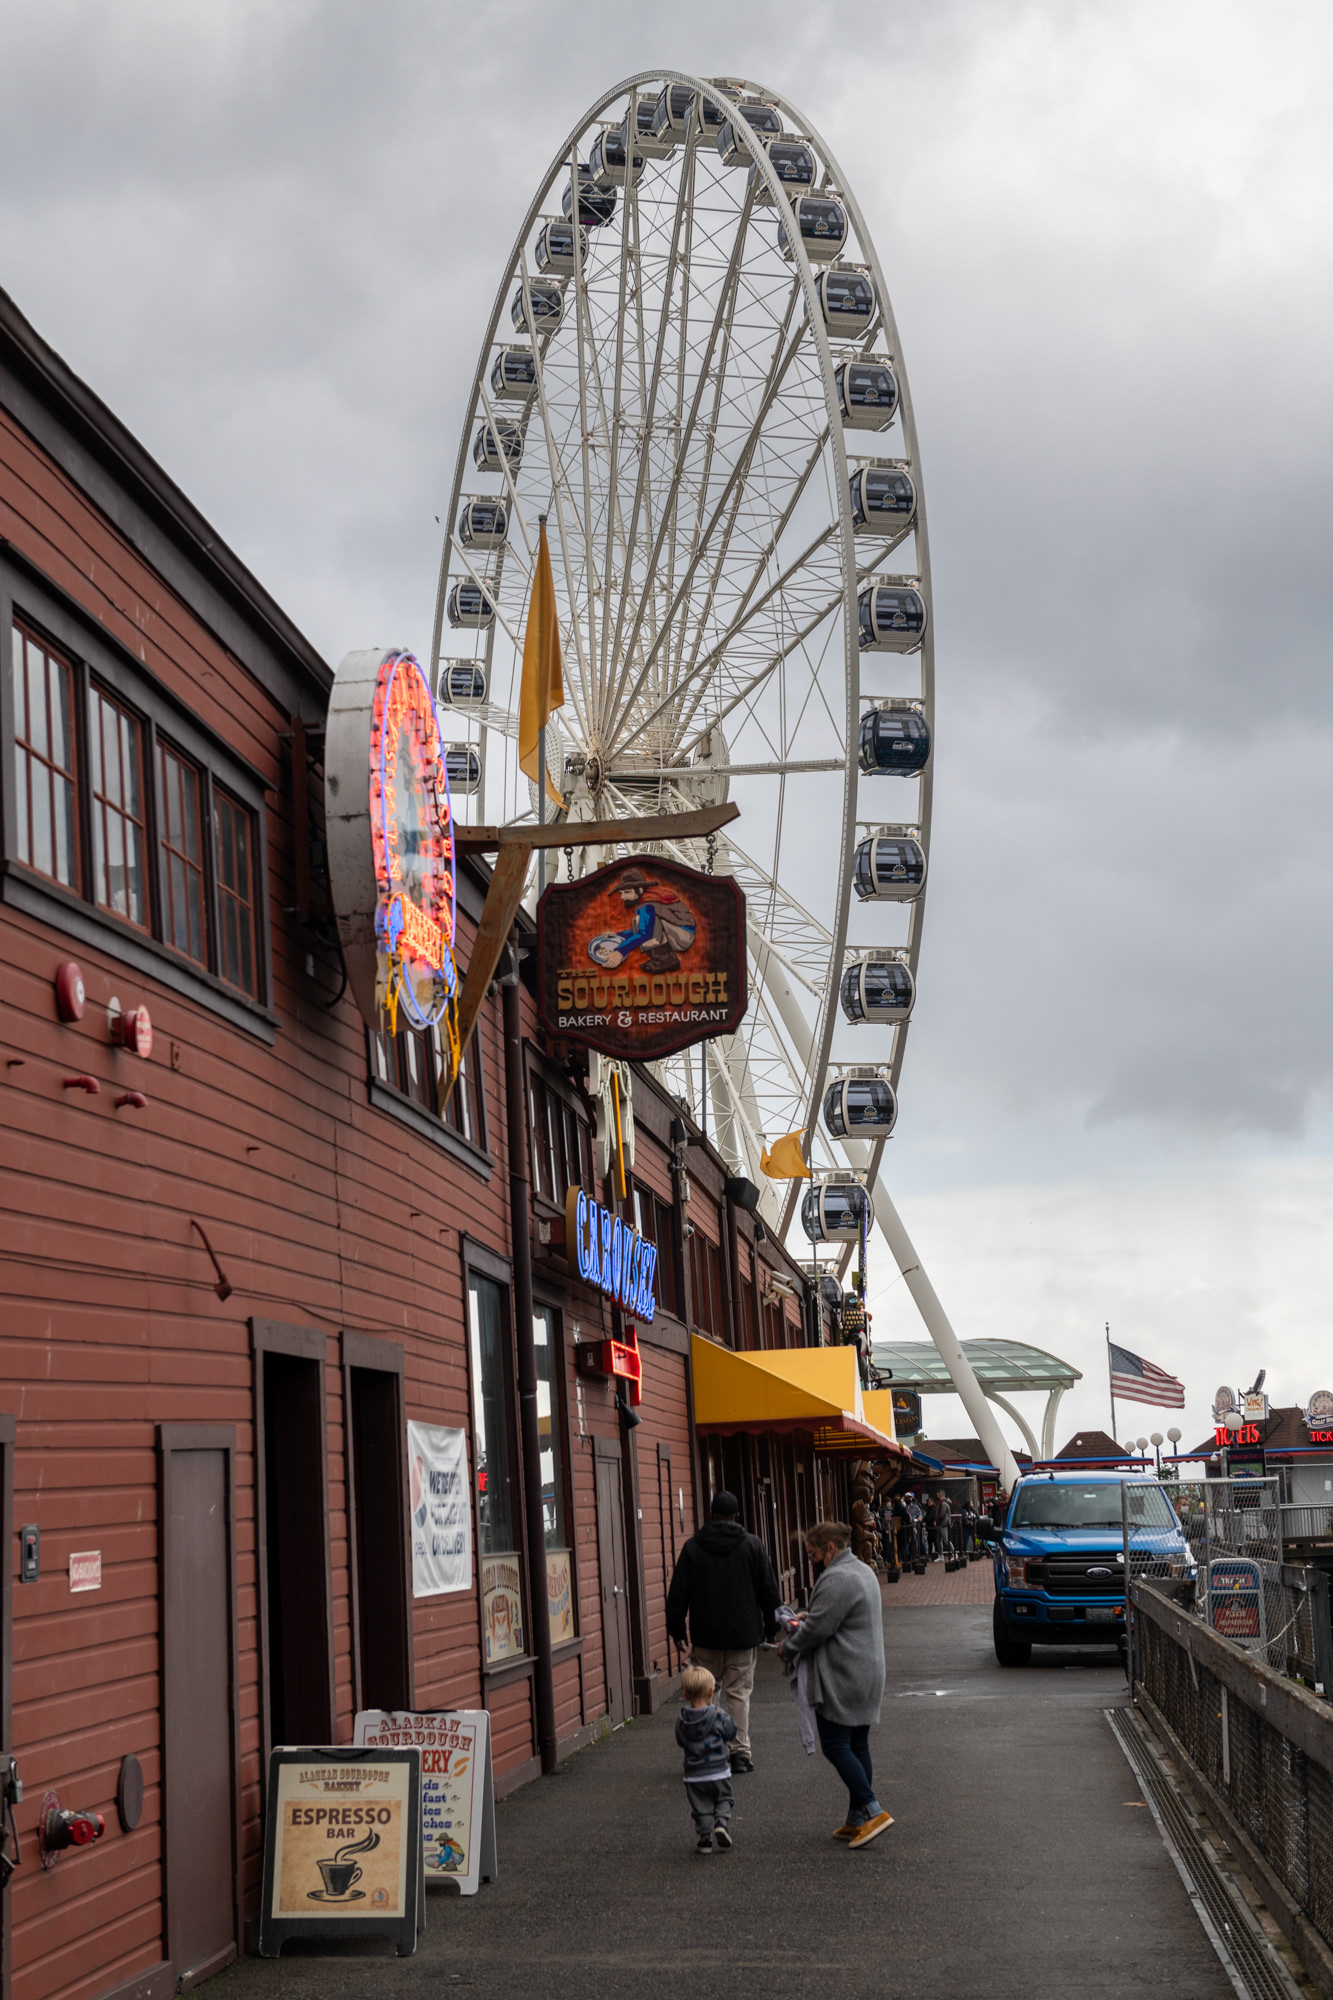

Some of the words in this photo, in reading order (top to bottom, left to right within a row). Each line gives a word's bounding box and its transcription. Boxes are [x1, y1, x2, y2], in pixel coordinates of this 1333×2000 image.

[557, 968, 598, 978] THE
[557, 972, 728, 1011] SOURDOUGH
[558, 1014, 613, 1028] BAKERY
[617, 1011, 633, 1028] &
[638, 1009, 729, 1024] RESTAURANT
[576, 1190, 658, 1322] CAROUSEL
[379, 1716, 461, 1733] ALASKAN
[367, 1731, 473, 1752] SOURDOUGH
[422, 1749, 453, 1774] ERY
[299, 1768, 338, 1783] ALASKAN
[339, 1768, 390, 1783] SOURDOUGH
[323, 1781, 361, 1792] BAKERY
[422, 1779, 439, 1790] ds
[422, 1792, 447, 1803] fast
[291, 1807, 392, 1825] ESPRESSO
[423, 1804, 442, 1816] ies
[423, 1817, 452, 1829] ches
[326, 1828, 356, 1839] BAR
